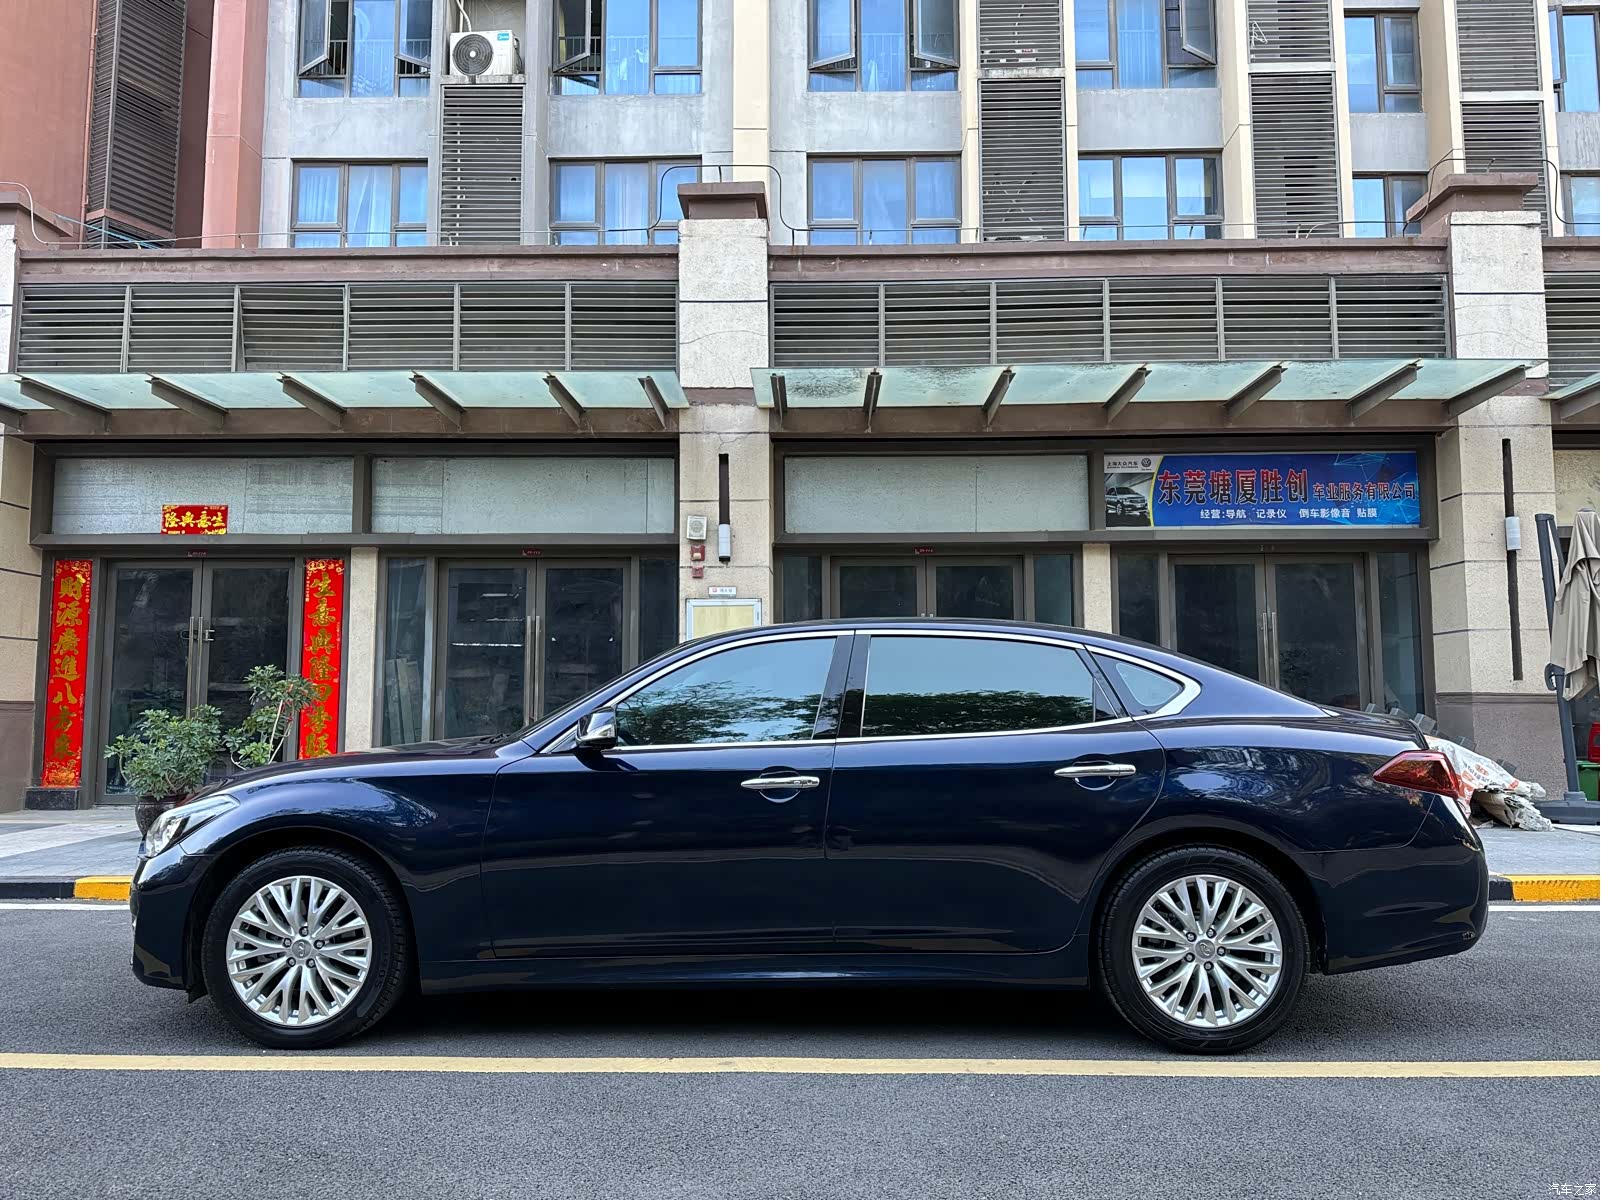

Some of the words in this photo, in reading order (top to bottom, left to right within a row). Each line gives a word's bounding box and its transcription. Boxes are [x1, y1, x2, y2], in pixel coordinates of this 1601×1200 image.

[1158, 468, 1309, 506] 东莞塘厦胜创
[1312, 481, 1417, 502] 车业服务有限公司
[1256, 508, 1287, 519] 记录仪
[1299, 508, 1351, 519] 倒车影像音
[1356, 508, 1378, 518] 贴膜
